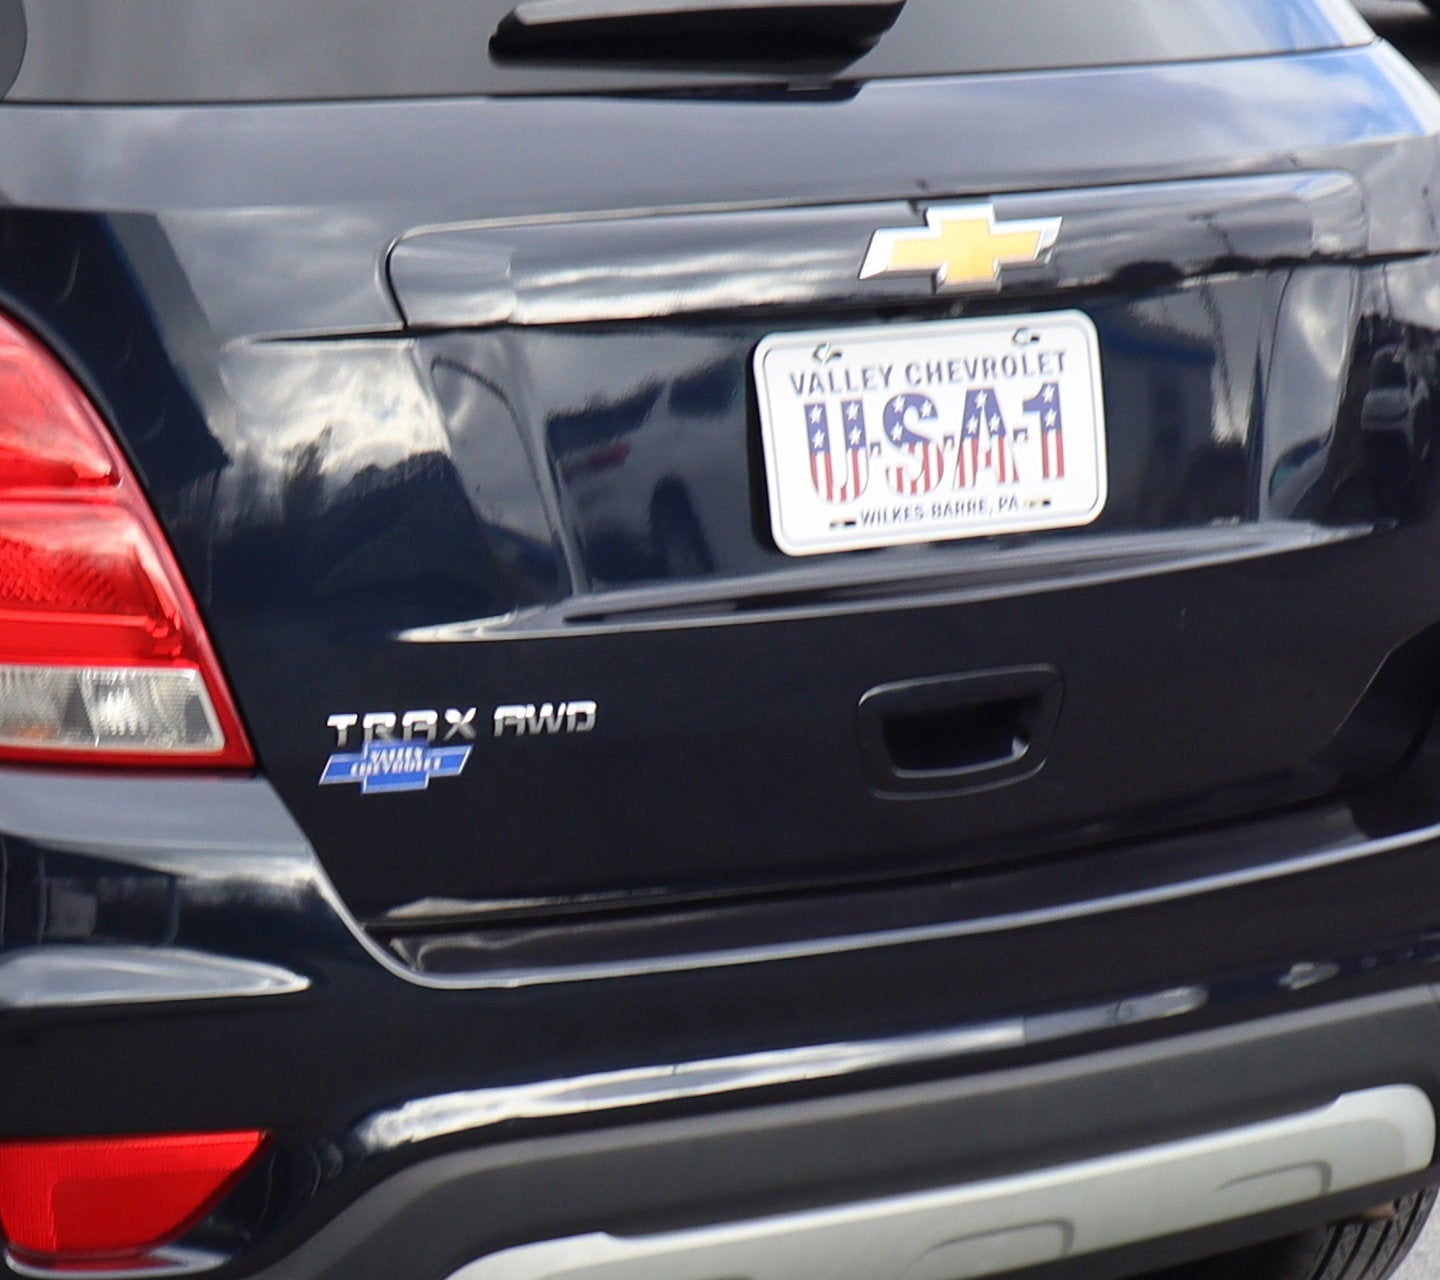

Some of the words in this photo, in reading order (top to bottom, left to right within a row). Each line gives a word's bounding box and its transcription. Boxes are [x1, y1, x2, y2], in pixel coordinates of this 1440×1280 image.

[790, 362, 894, 397] VALLEY
[904, 350, 1068, 387] CHEVROLET
[997, 495, 1020, 512] PA
[327, 707, 478, 747] TRAX
[494, 700, 598, 737] AWD
